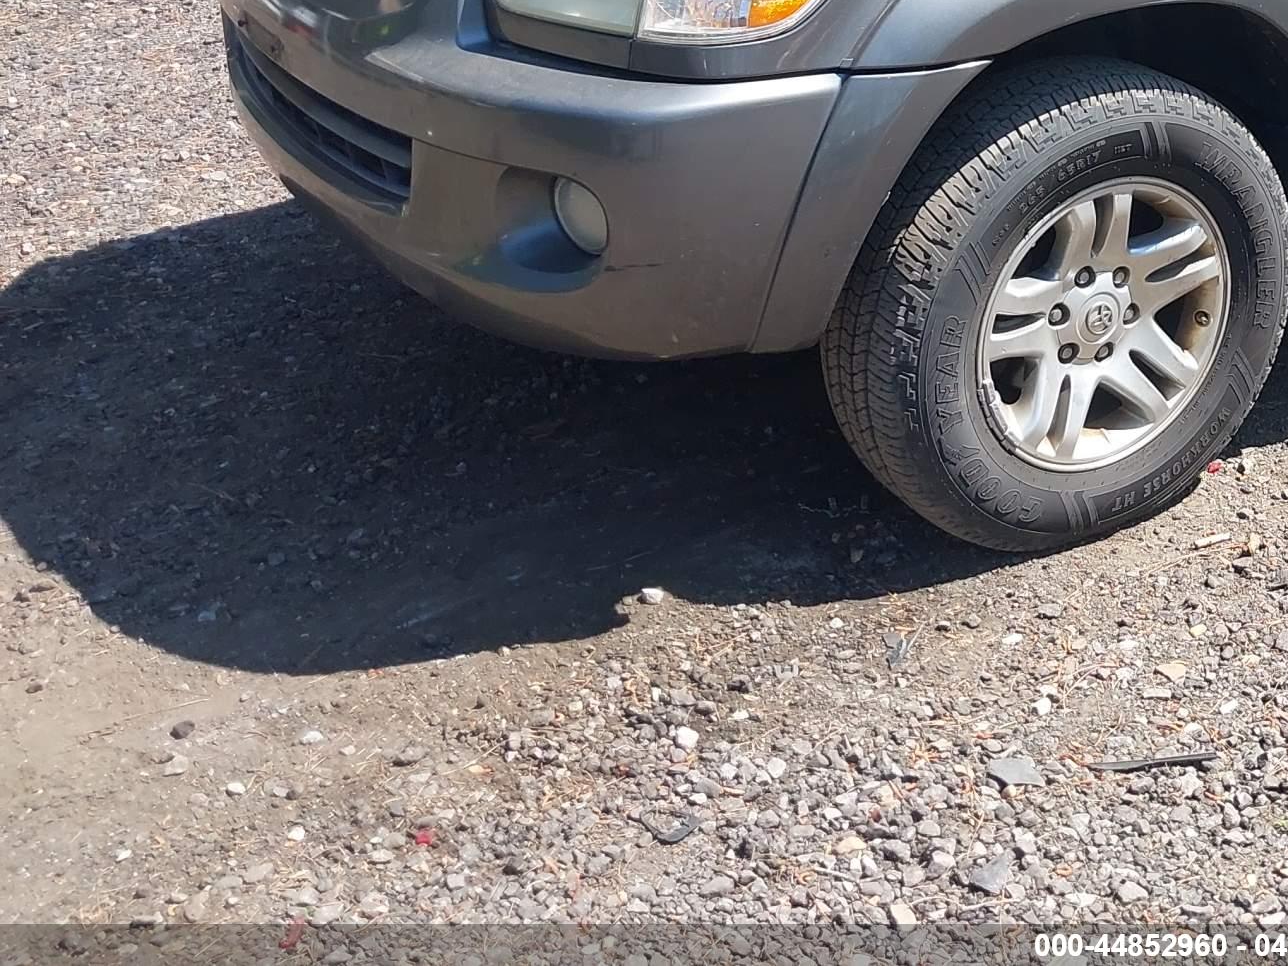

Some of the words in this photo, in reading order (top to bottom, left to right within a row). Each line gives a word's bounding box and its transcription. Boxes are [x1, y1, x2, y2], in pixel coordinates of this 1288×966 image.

[1195, 140, 1278, 330] WRANGLER
[935, 315, 1044, 523] GOODYEAR
[1143, 406, 1232, 498] WORKHORSE
[1111, 490, 1136, 513] HT
